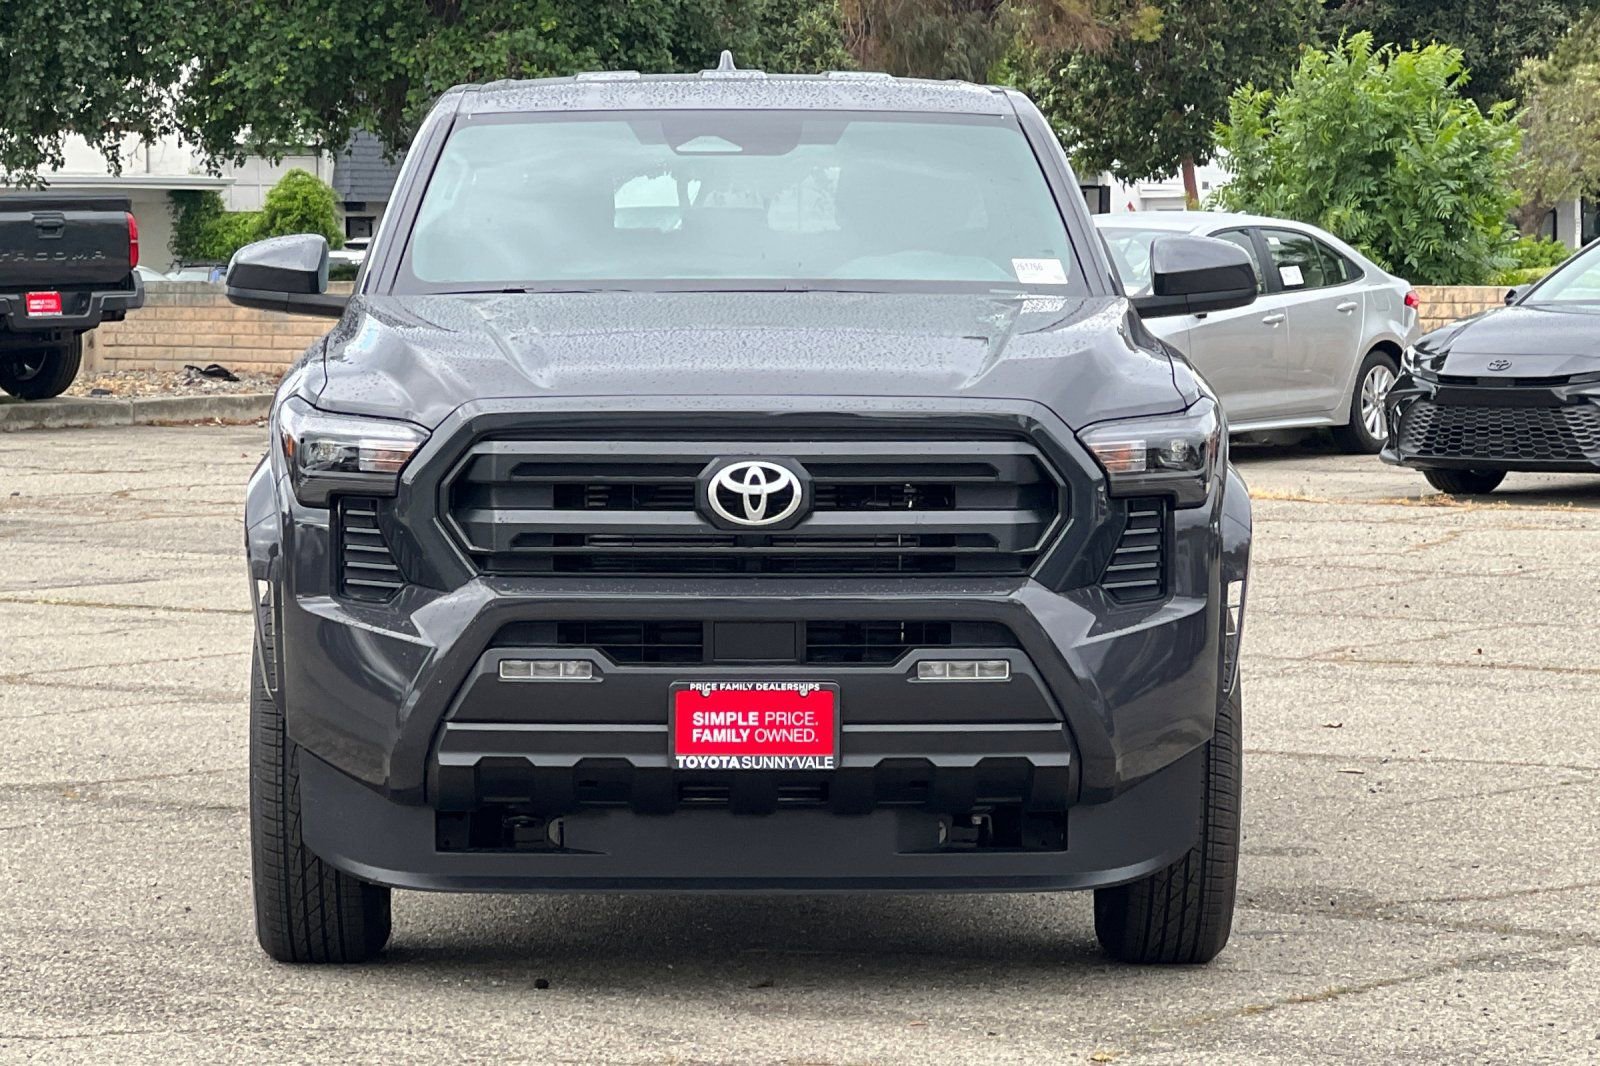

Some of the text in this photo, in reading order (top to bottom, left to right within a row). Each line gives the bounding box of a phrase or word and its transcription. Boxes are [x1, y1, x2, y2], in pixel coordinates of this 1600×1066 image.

[690, 683, 820, 691] PRICE FAMILY DEALERSHIPS
[692, 711, 819, 726] SIMPLE PRICE.
[692, 729, 819, 742] FAMILY OWNED.
[676, 756, 834, 769] TOYOTA SUNNYVALE
